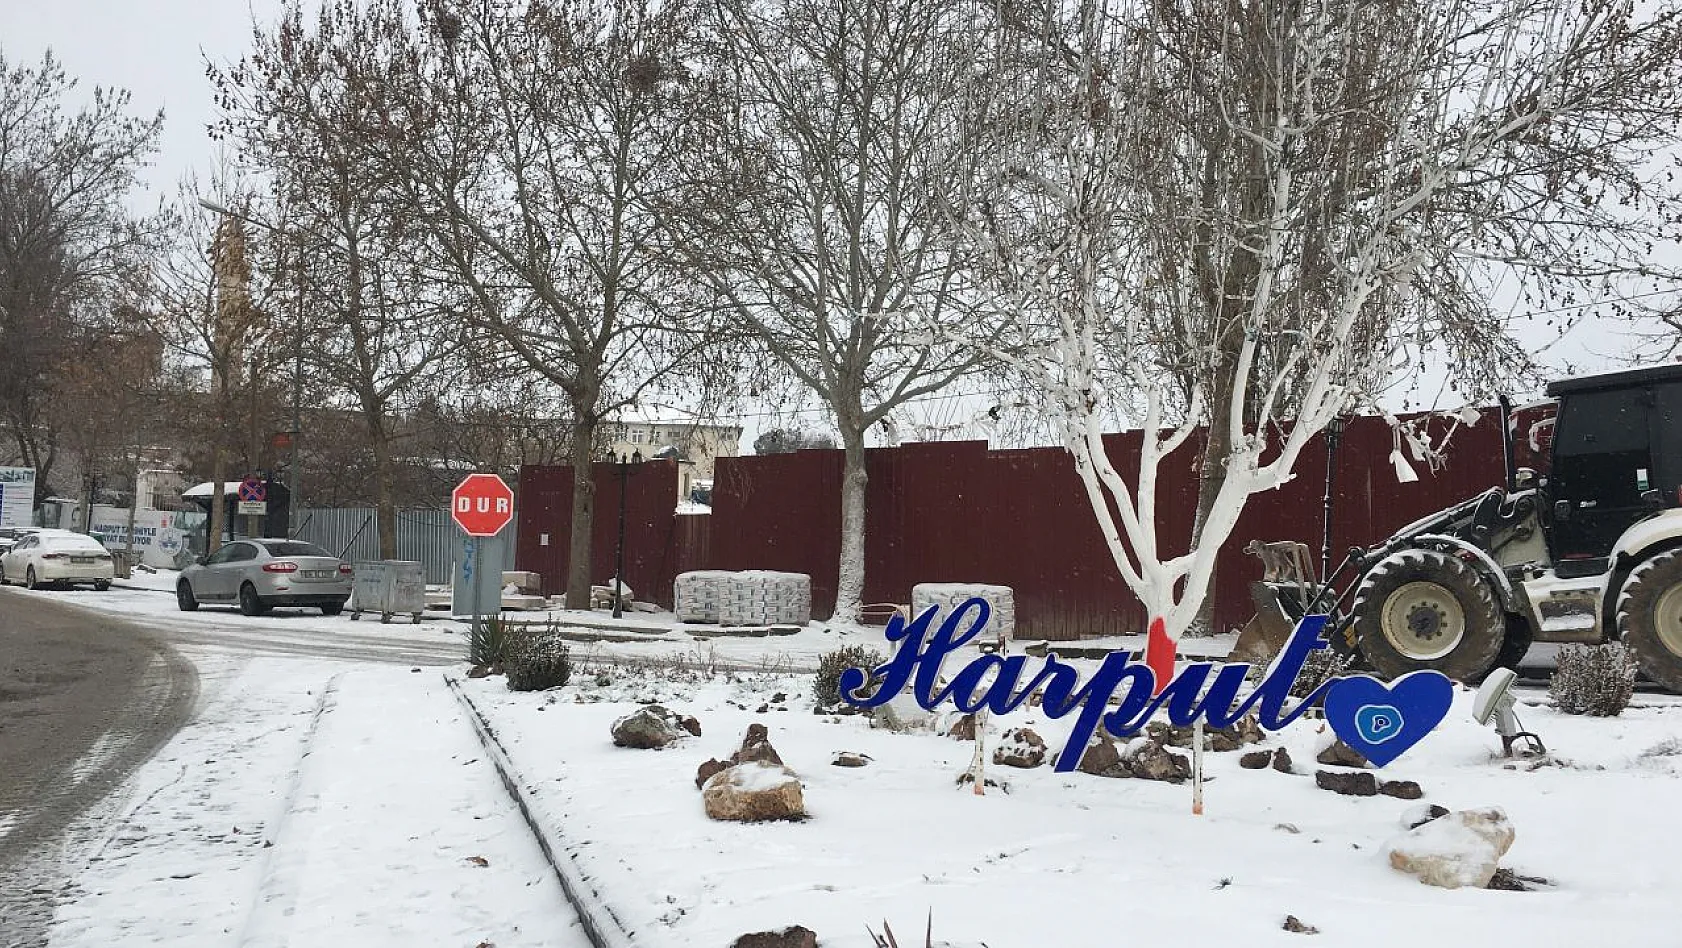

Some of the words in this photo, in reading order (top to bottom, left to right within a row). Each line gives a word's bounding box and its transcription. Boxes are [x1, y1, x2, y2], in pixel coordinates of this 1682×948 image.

[458, 497, 508, 513] DUR
[119, 535, 151, 545] BUUYOR
[839, 597, 1334, 773] Harput
